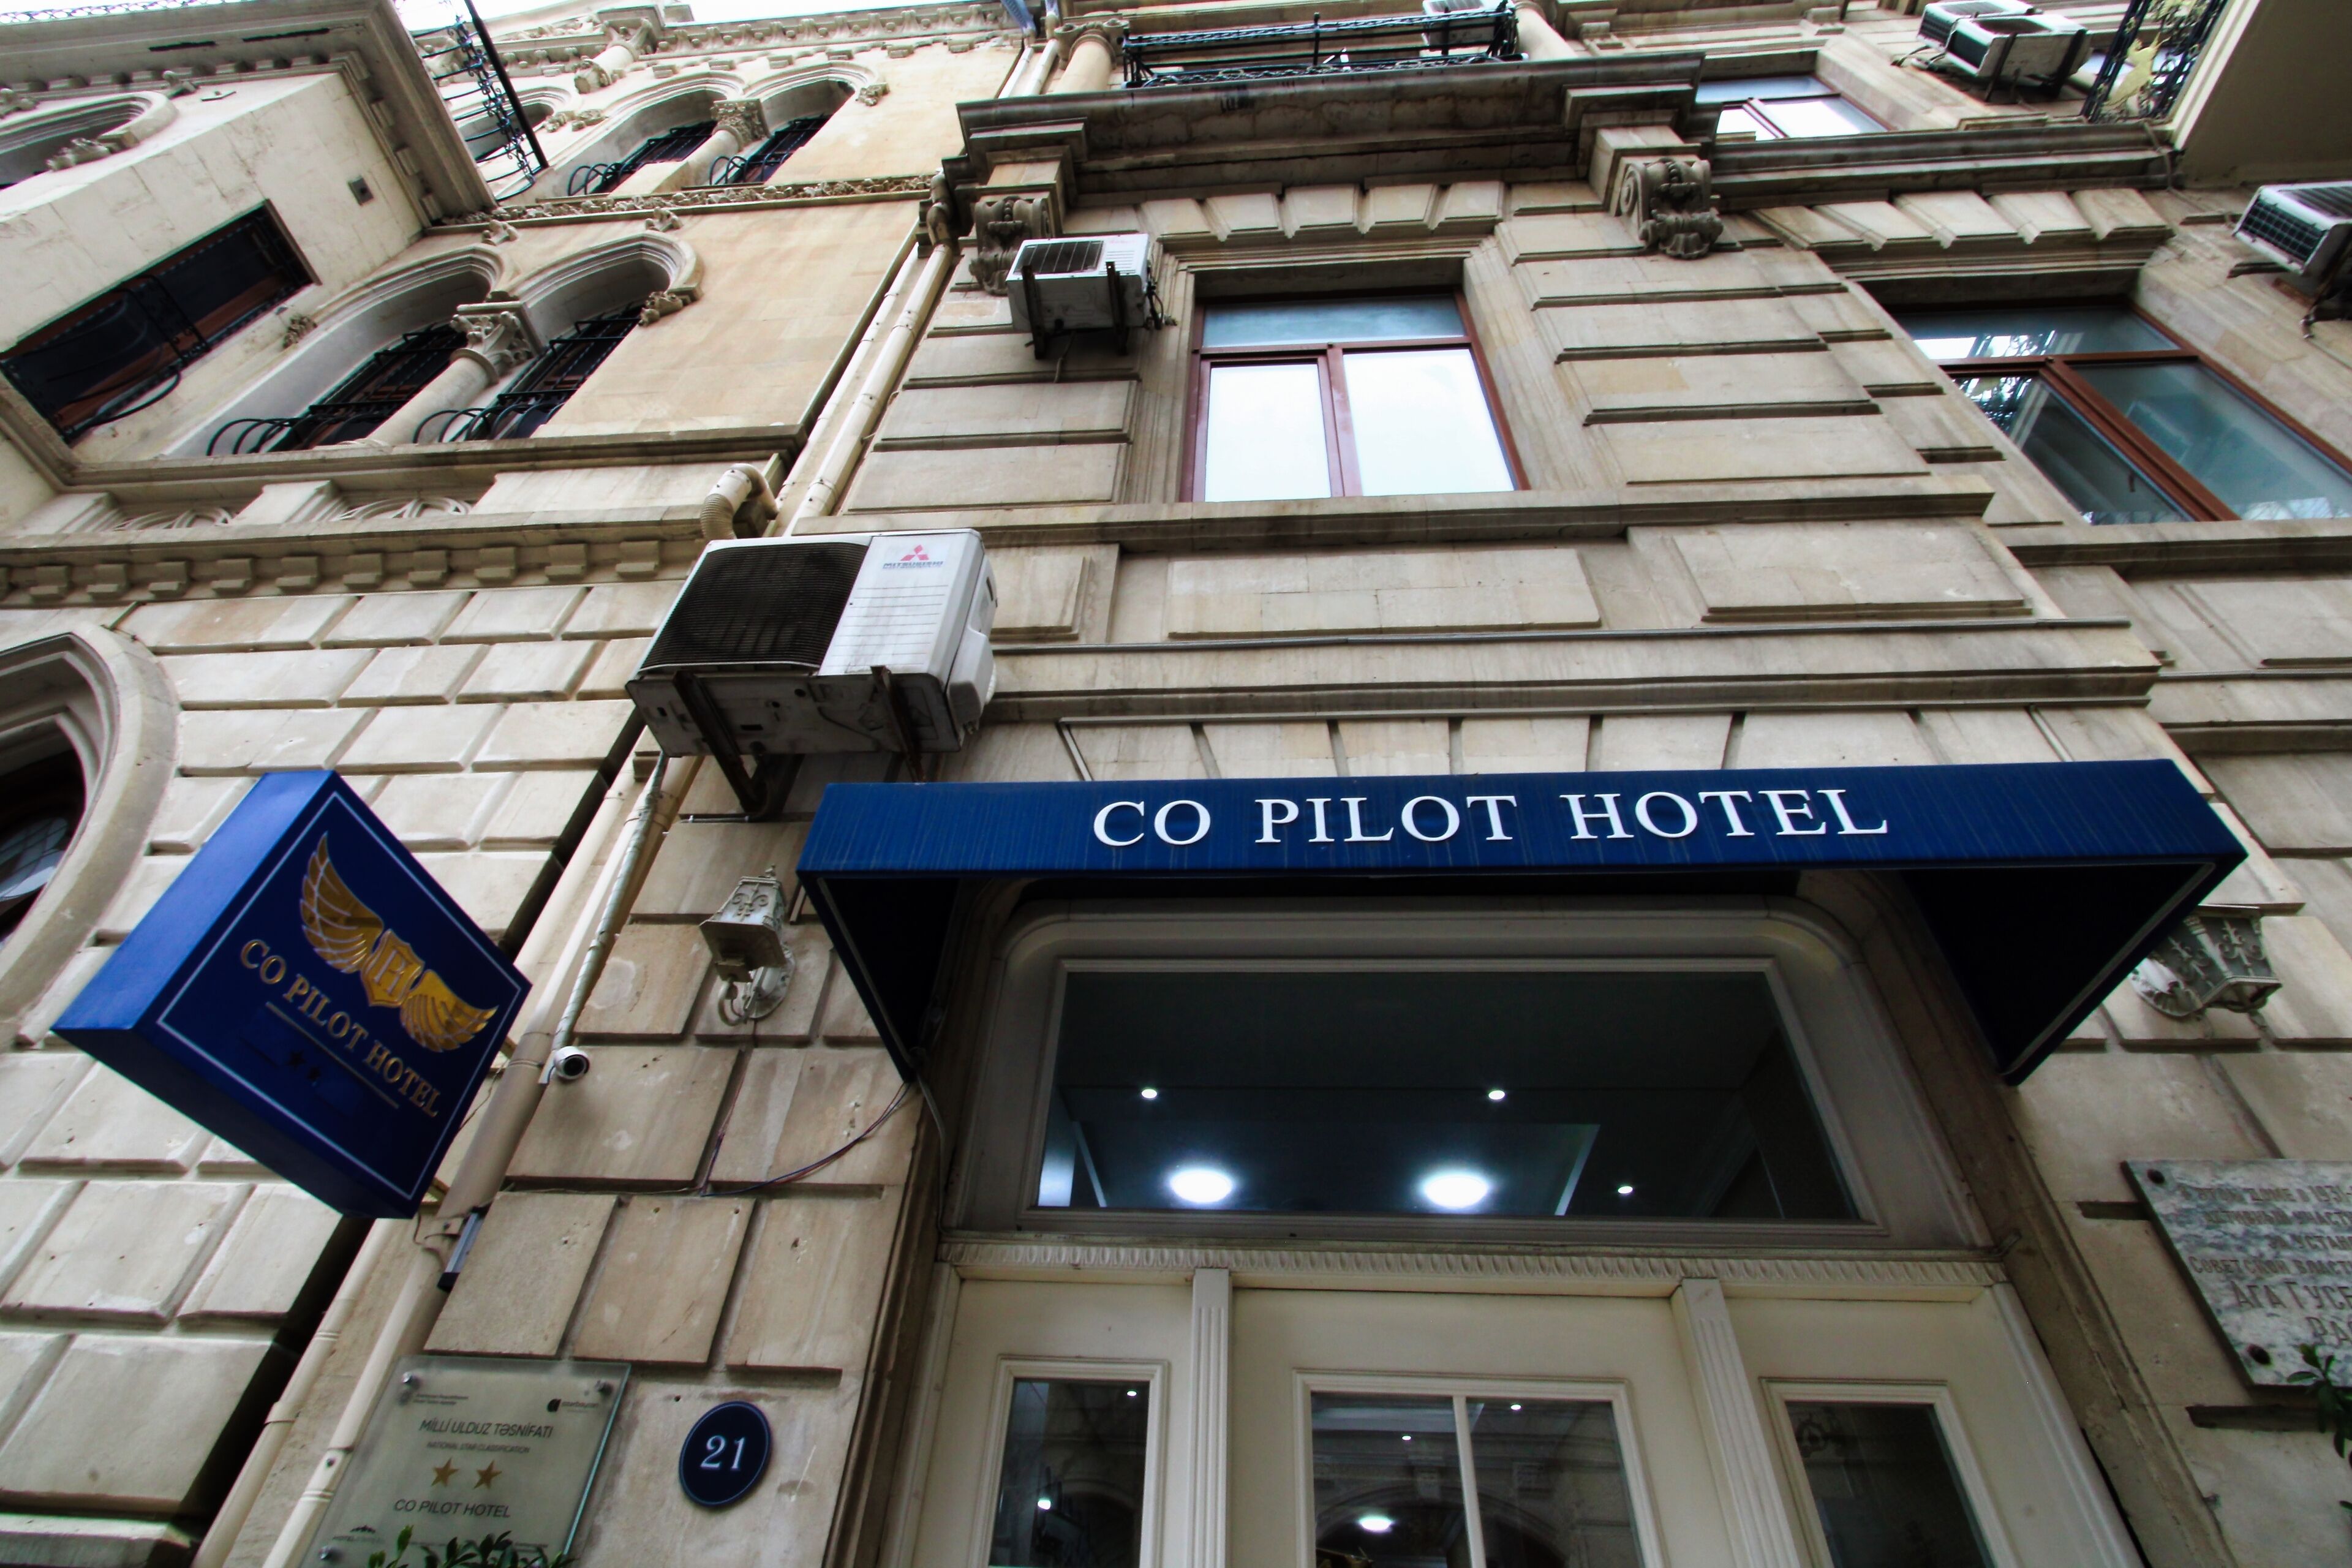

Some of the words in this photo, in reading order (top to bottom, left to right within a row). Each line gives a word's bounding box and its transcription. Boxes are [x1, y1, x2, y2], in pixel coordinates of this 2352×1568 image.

[1093, 800, 1211, 846] CO
[1254, 796, 1517, 843] PILOT
[1559, 789, 1888, 839] HOTEL
[241, 939, 286, 984] CO
[282, 973, 369, 1052] PILOT
[362, 1039, 441, 1117] HOTEL
[451, 1422, 492, 1435] ULDUZ
[700, 1434, 745, 1469] 21
[394, 1498, 415, 1512] CO
[418, 1501, 462, 1515] PILOT
[464, 1504, 511, 1518] HOTEL
